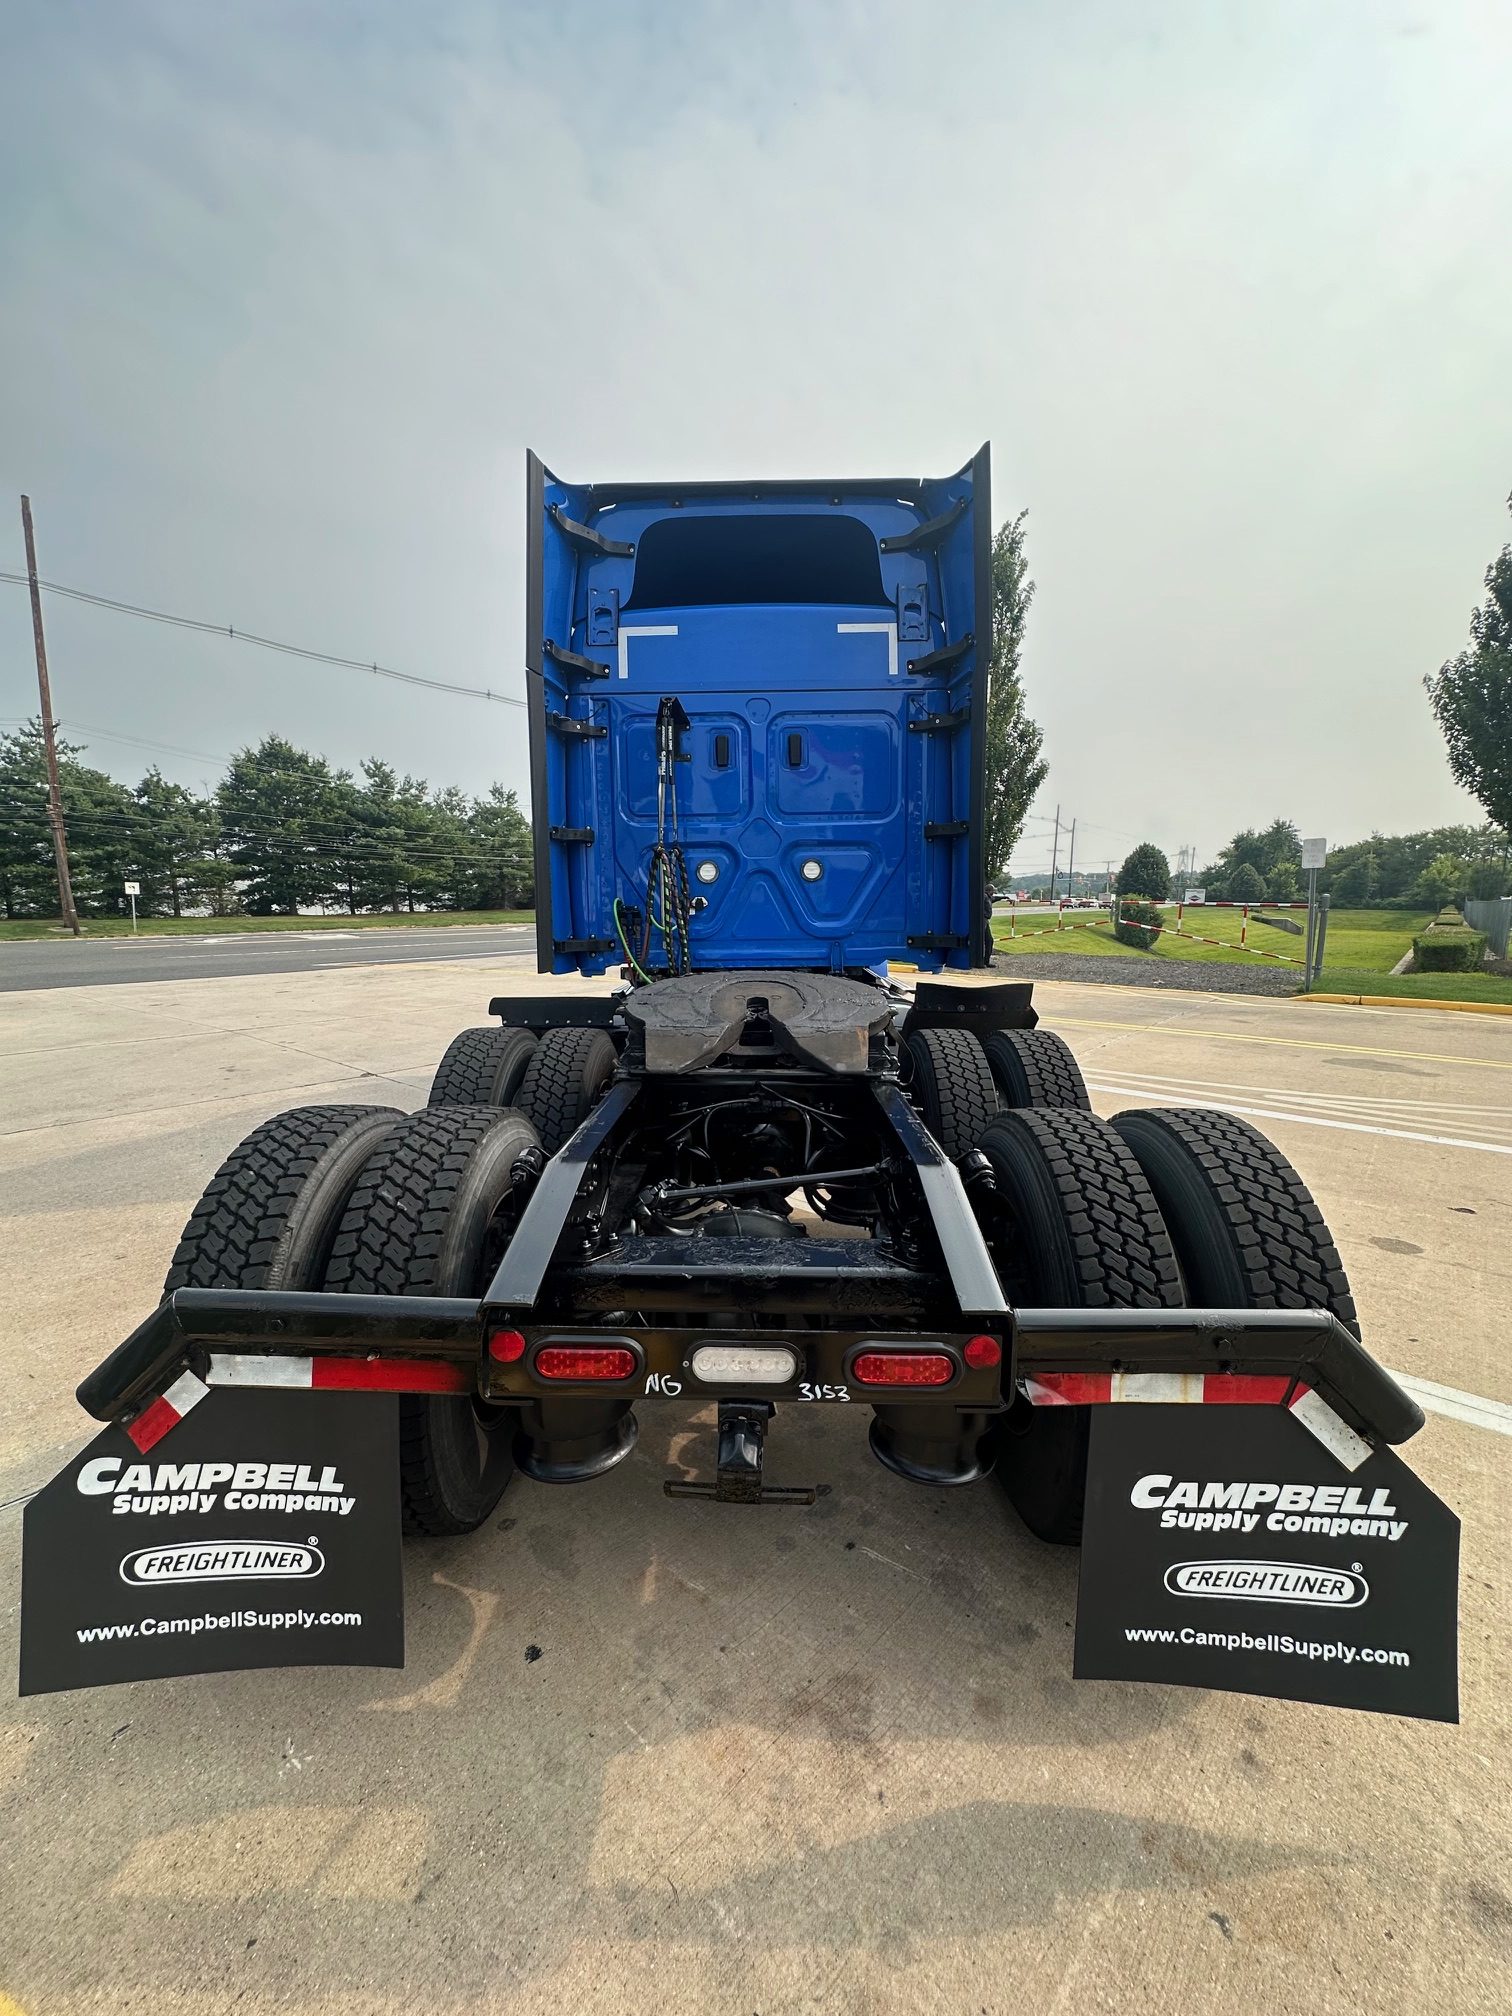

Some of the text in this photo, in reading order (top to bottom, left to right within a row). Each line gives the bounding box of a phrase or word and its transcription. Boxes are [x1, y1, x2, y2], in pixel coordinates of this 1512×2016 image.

[644, 1372, 682, 1396] NG
[797, 1382, 851, 1402] 3153
[76, 1456, 345, 1496] CAMPBELL
[111, 1491, 356, 1516] Supply Company
[1130, 1473, 1397, 1517] CAMPBELL
[1159, 1509, 1409, 1541] Supply Company
[144, 1551, 304, 1575] FREIGHTLINER
[1184, 1570, 1346, 1596] FREIGHTLINER
[76, 1609, 362, 1643] www.CampbellSupply.com
[1124, 1627, 1410, 1667] www.CampbellSupply.com
